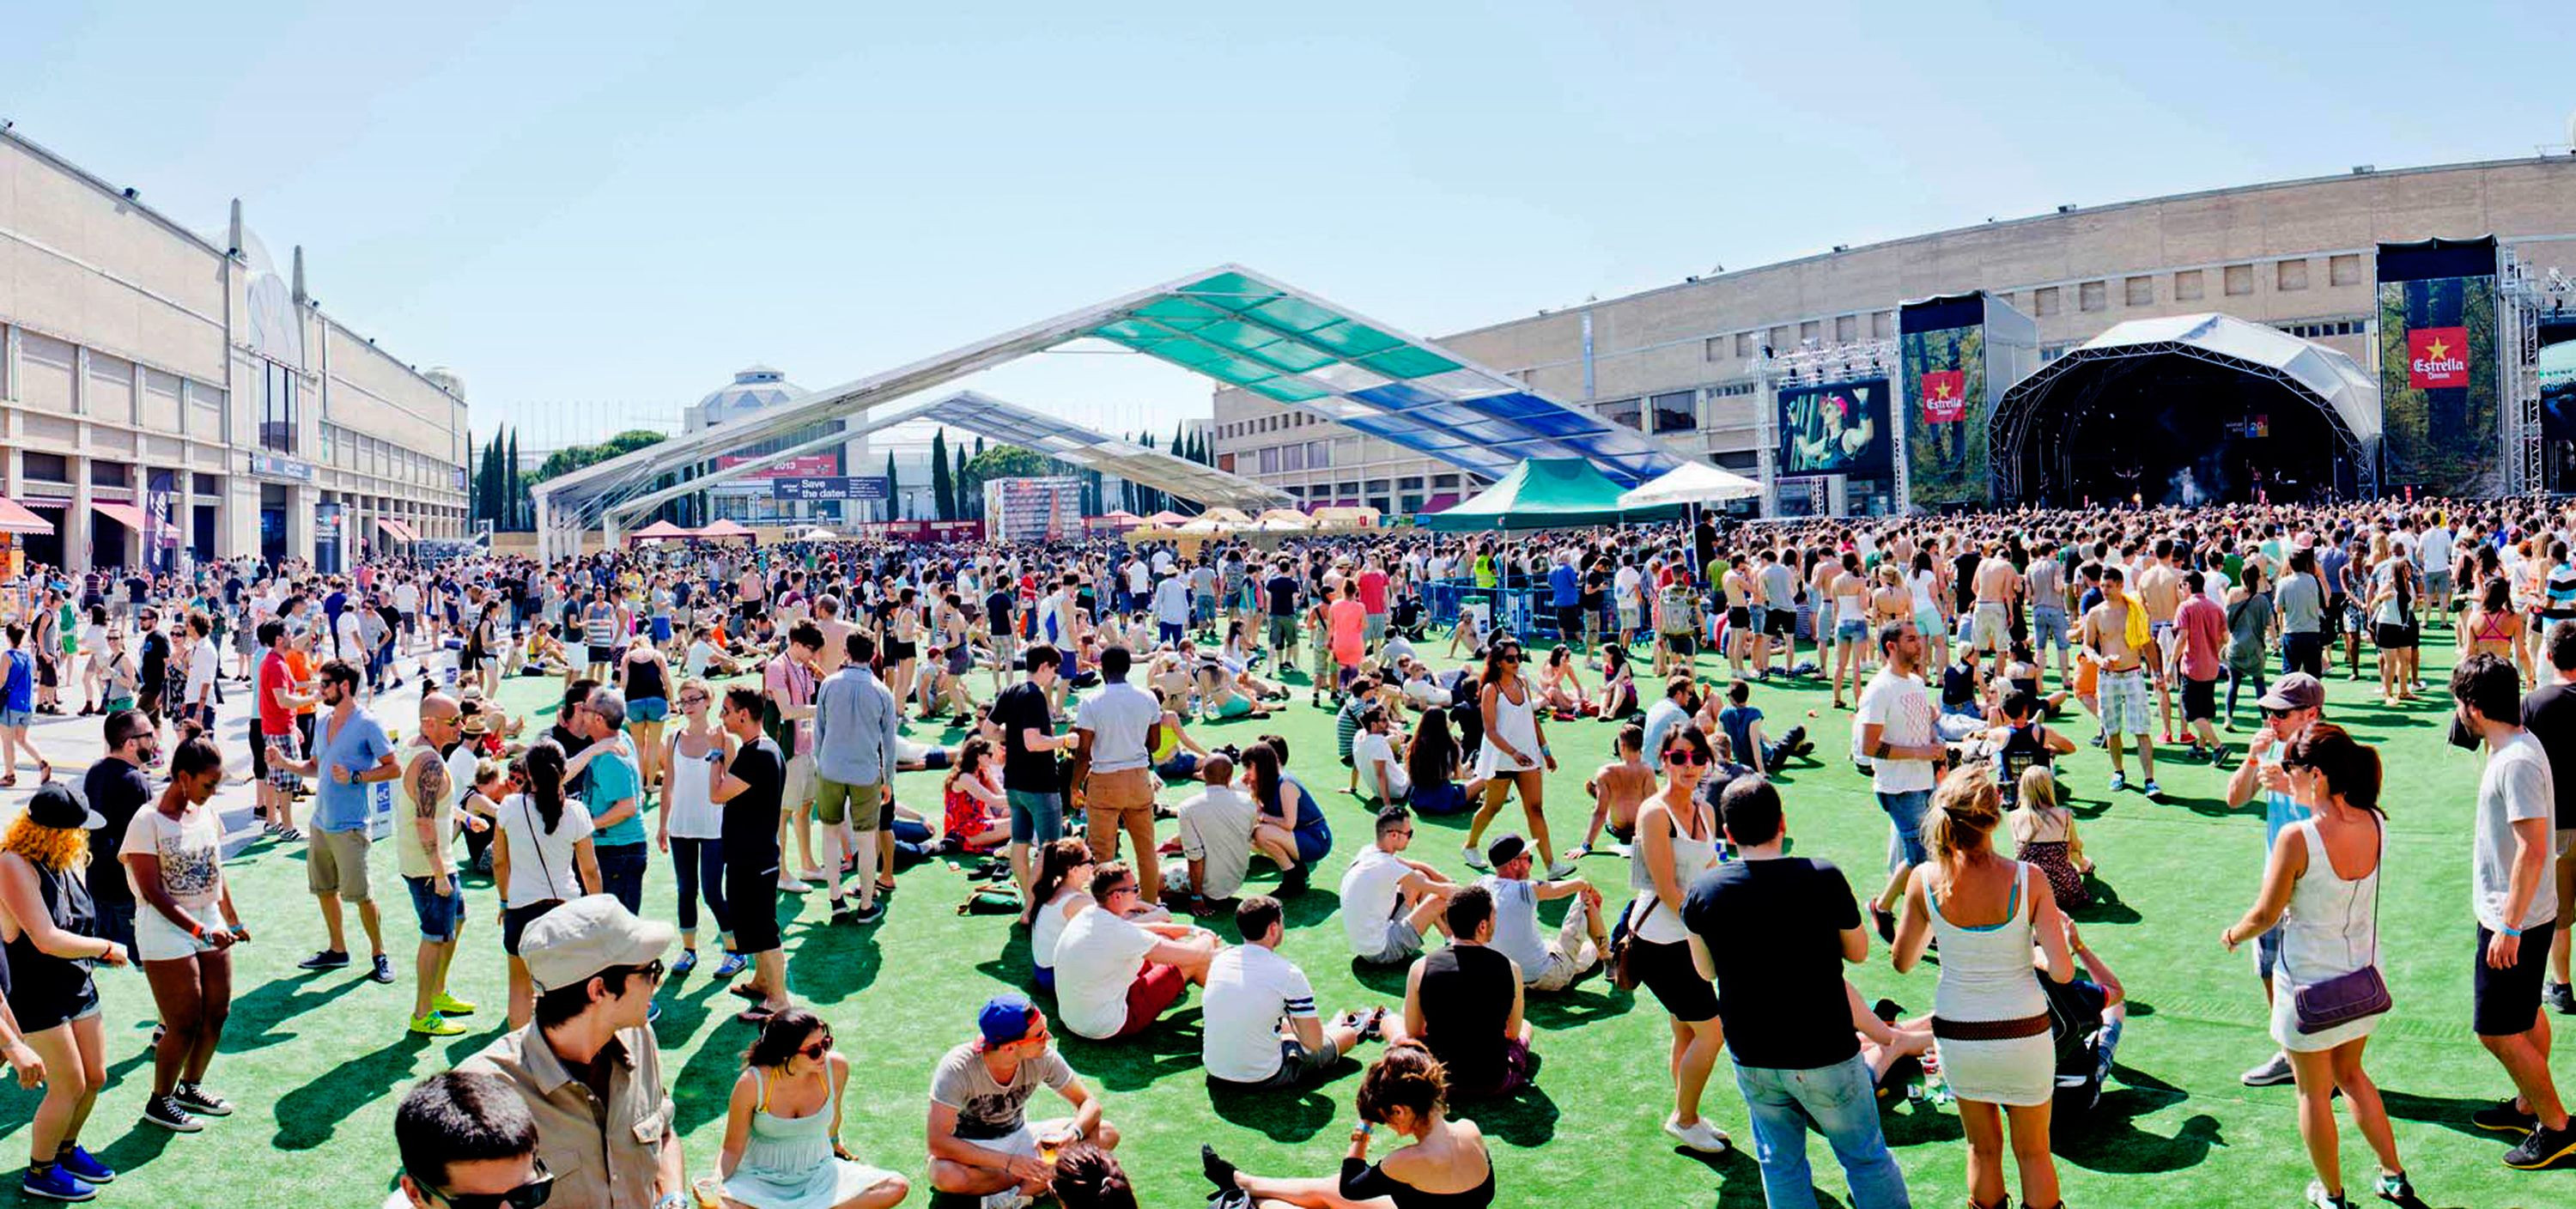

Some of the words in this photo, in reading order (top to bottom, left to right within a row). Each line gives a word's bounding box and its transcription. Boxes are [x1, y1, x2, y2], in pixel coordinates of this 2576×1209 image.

[2414, 356, 2464, 374] Estrella
[1927, 397, 1962, 410] Estrella
[774, 461, 796, 471] 2013
[801, 479, 826, 489] Save
[801, 489, 817, 498] the
[819, 489, 847, 498] dates
